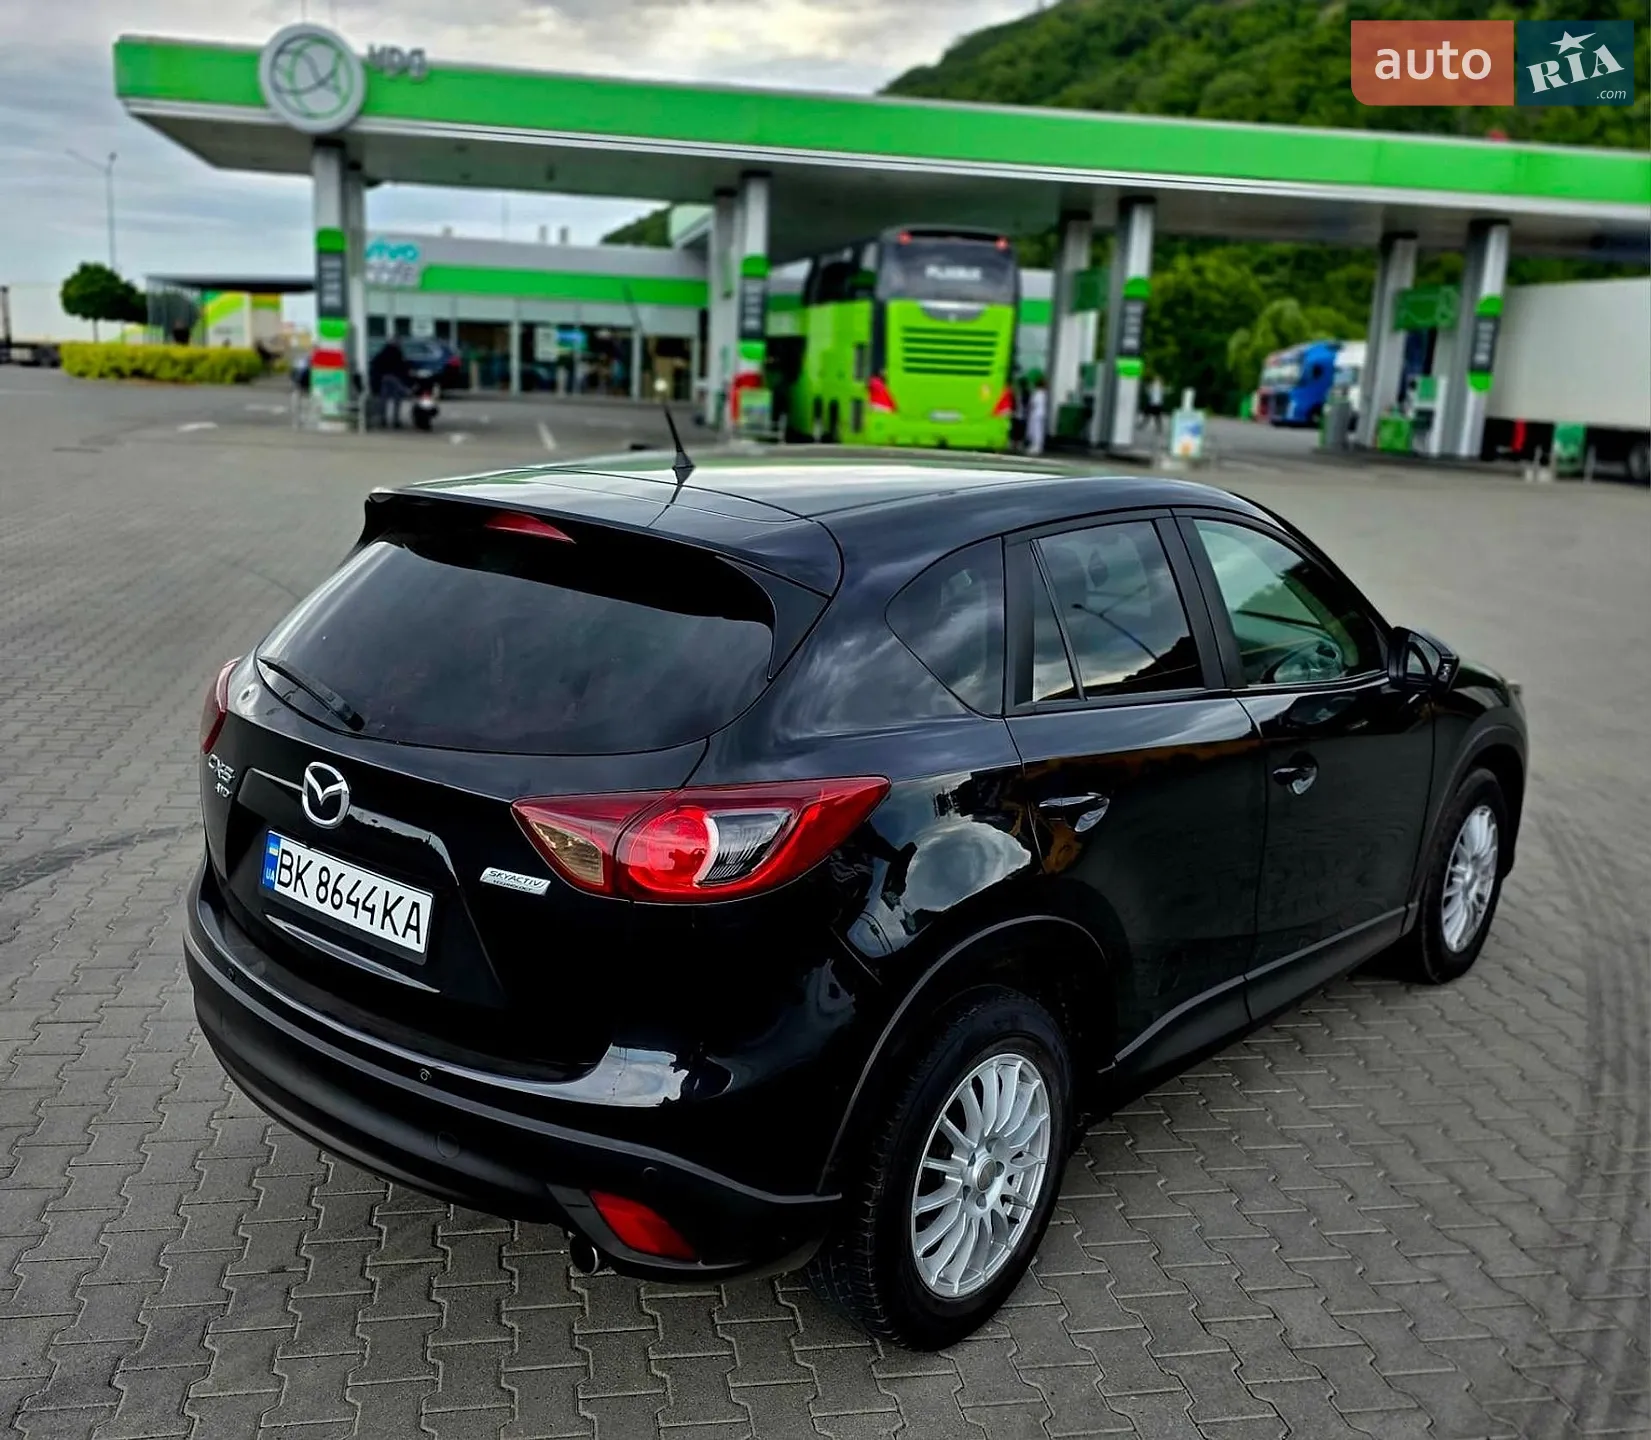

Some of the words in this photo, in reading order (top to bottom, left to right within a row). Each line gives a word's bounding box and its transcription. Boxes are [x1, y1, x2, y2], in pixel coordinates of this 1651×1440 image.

[265, 867, 275, 883] UA
[277, 848, 313, 898] BK
[488, 870, 542, 886] SKYACTIV
